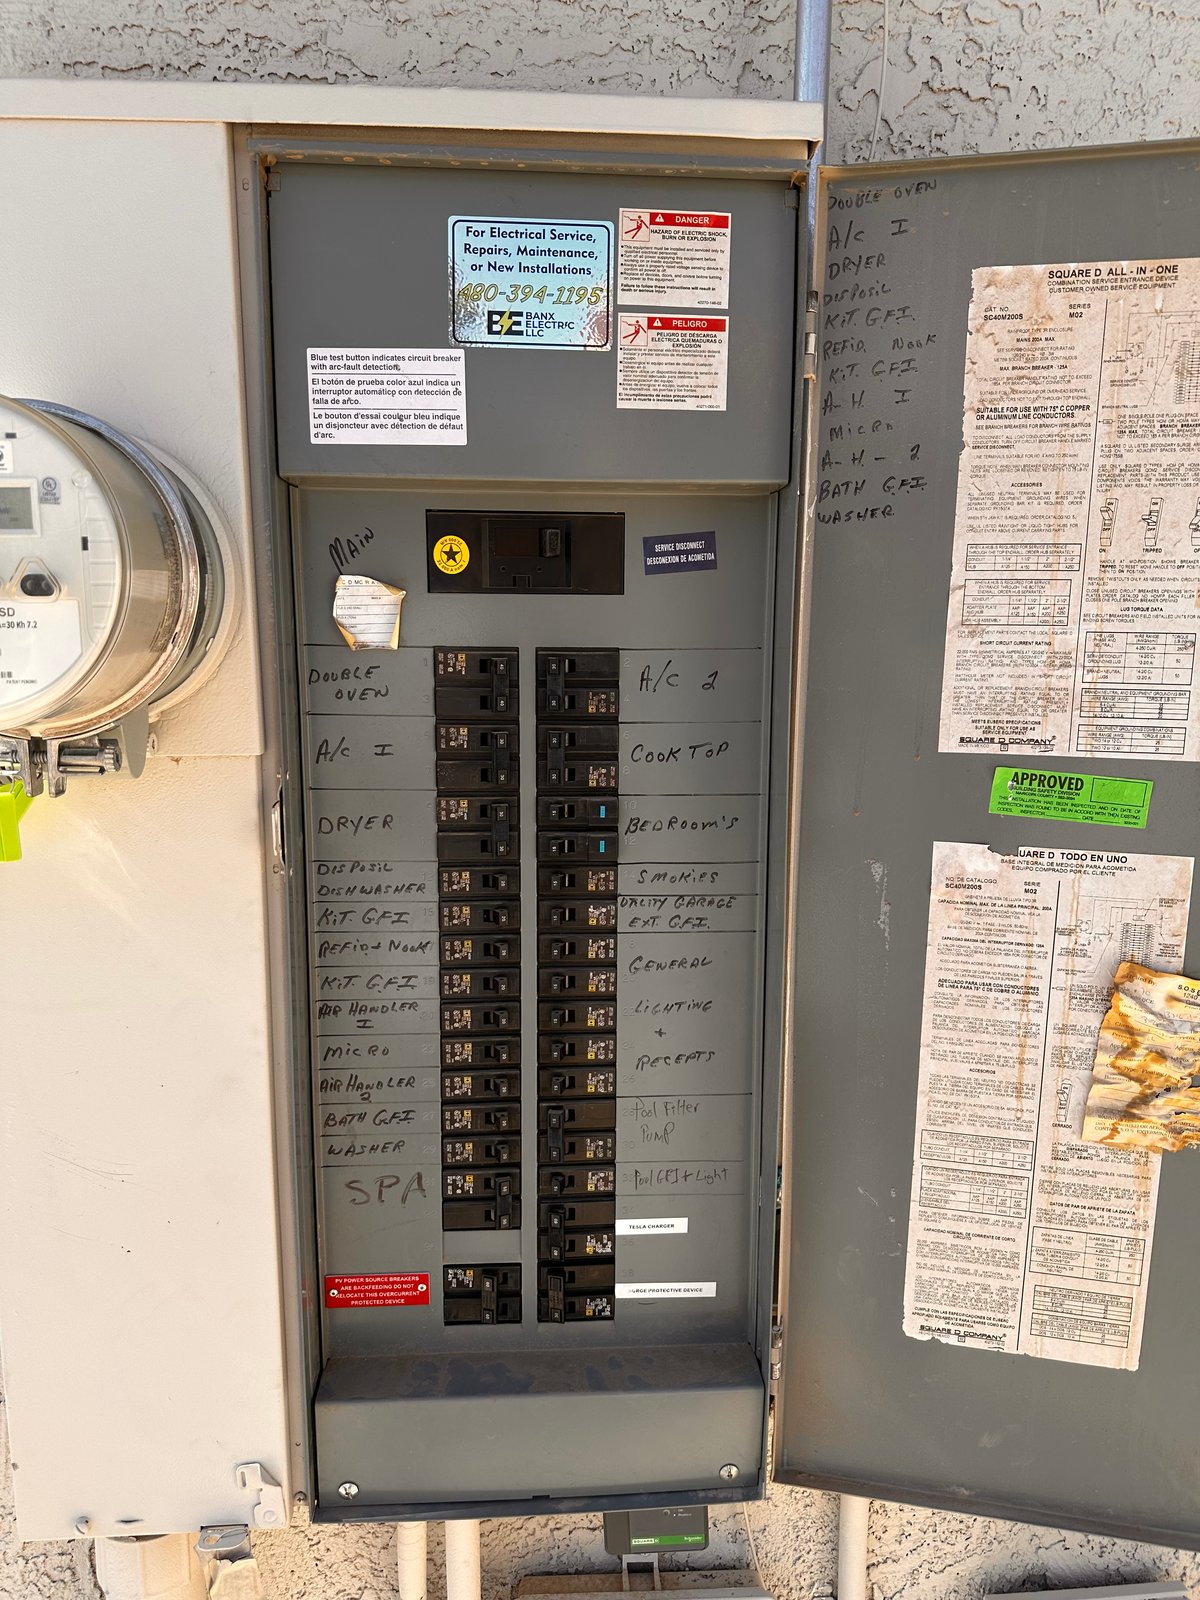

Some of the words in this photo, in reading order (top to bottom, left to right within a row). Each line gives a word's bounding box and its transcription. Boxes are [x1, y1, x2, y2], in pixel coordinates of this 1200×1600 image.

[894, 179, 937, 199] OVEN
[676, 216, 709, 224] DANGER
[466, 226, 486, 238] For
[490, 227, 546, 240] Electrical
[550, 229, 596, 243] Service,
[464, 243, 512, 257] Repairs,
[517, 246, 598, 260] Maintenance,
[471, 264, 482, 272] or
[486, 261, 514, 273] New
[518, 262, 591, 275] Installations
[829, 253, 886, 280] DRYER
[1048, 269, 1091, 279] SQUARE
[1095, 268, 1101, 277] D
[1107, 268, 1126, 276] ALL
[1136, 266, 1146, 275] IN
[1156, 265, 1178, 274] ONE
[458, 283, 603, 305] 480-394-1195
[526, 312, 555, 321] BANX
[526, 320, 575, 330] ELECTRIC
[526, 329, 544, 337] LLC
[358, 379, 384, 387] prueba
[312, 388, 352, 396] interruptor
[432, 413, 460, 422] indique
[326, 422, 368, 430] disjoncteur
[819, 480, 866, 503] BATH
[655, 543, 674, 552] SERVICE
[676, 541, 705, 550] DISCONNECT
[647, 555, 679, 565] DESCONEXION
[688, 553, 715, 562] ACOMETIDA
[308, 666, 380, 685] DOUBLE
[640, 660, 679, 692] A/C
[702, 671, 718, 690] 2
[335, 685, 389, 701] OVEN
[631, 744, 681, 763] COOK
[689, 741, 729, 760] TOP
[1011, 772, 1084, 792] APPROVED
[318, 815, 393, 836] DRYER
[1019, 850, 1044, 859] UARE
[1060, 852, 1087, 861] TODO
[1106, 855, 1127, 863] UNO
[674, 896, 736, 909] GARAGE
[629, 956, 712, 974] GENERAL
[349, 1002, 418, 1016] HANDLER
[636, 1051, 715, 1071] RECEPTS
[346, 1074, 415, 1092] HANDLER
[664, 1099, 700, 1117] Filter
[324, 1112, 367, 1128] BATH
[328, 1140, 405, 1157] WASHER
[345, 1172, 427, 1208] SPA
